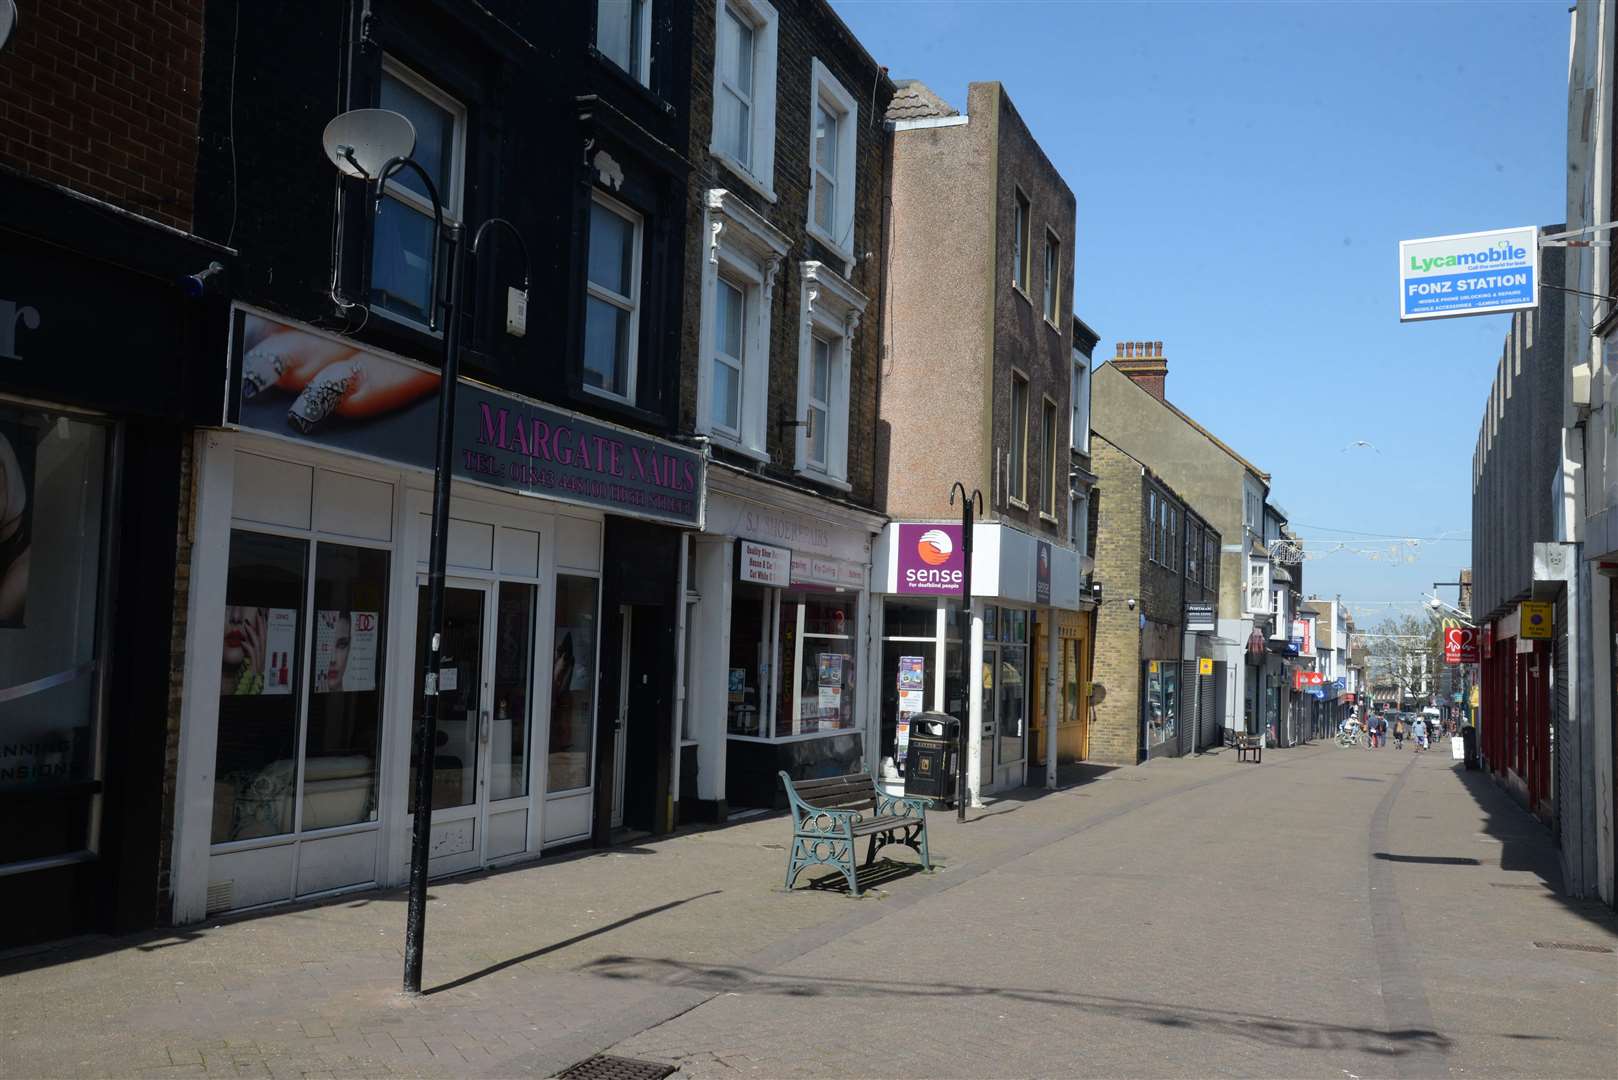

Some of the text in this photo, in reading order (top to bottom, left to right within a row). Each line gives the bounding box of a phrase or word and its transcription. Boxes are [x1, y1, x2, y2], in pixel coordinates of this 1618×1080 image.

[1411, 245, 1527, 272] Lycamobile
[1409, 273, 1527, 296] FONZ STATION
[477, 400, 696, 494] MARGATE NAILS
[906, 568, 963, 583] sense
